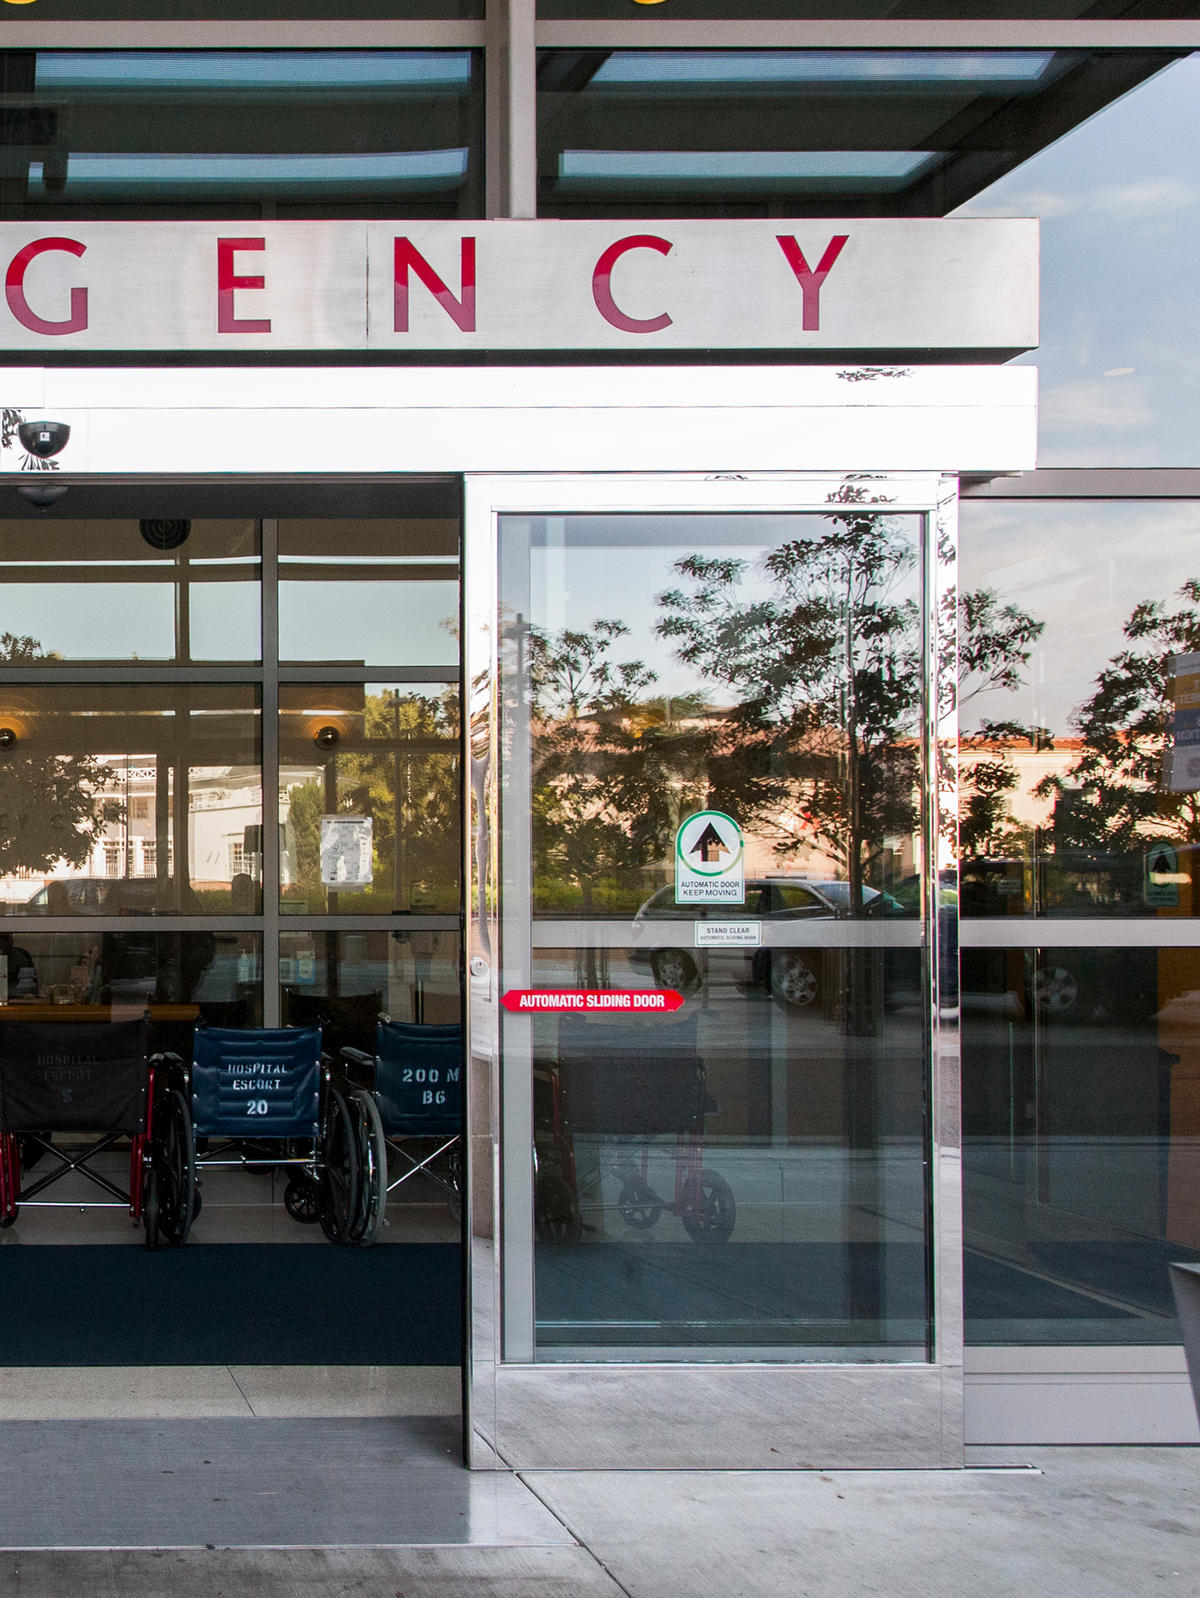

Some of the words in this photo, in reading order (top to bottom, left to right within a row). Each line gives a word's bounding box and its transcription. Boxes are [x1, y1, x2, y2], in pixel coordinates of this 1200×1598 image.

[519, 995, 584, 1008] AUTOMATIC
[586, 995, 631, 1008] SLIDING
[633, 995, 665, 1008] DOOR
[227, 1063, 288, 1074] HOSPITAL
[402, 1068, 439, 1083] 200
[232, 1079, 281, 1091] ESCORT
[246, 1099, 268, 1115] 20
